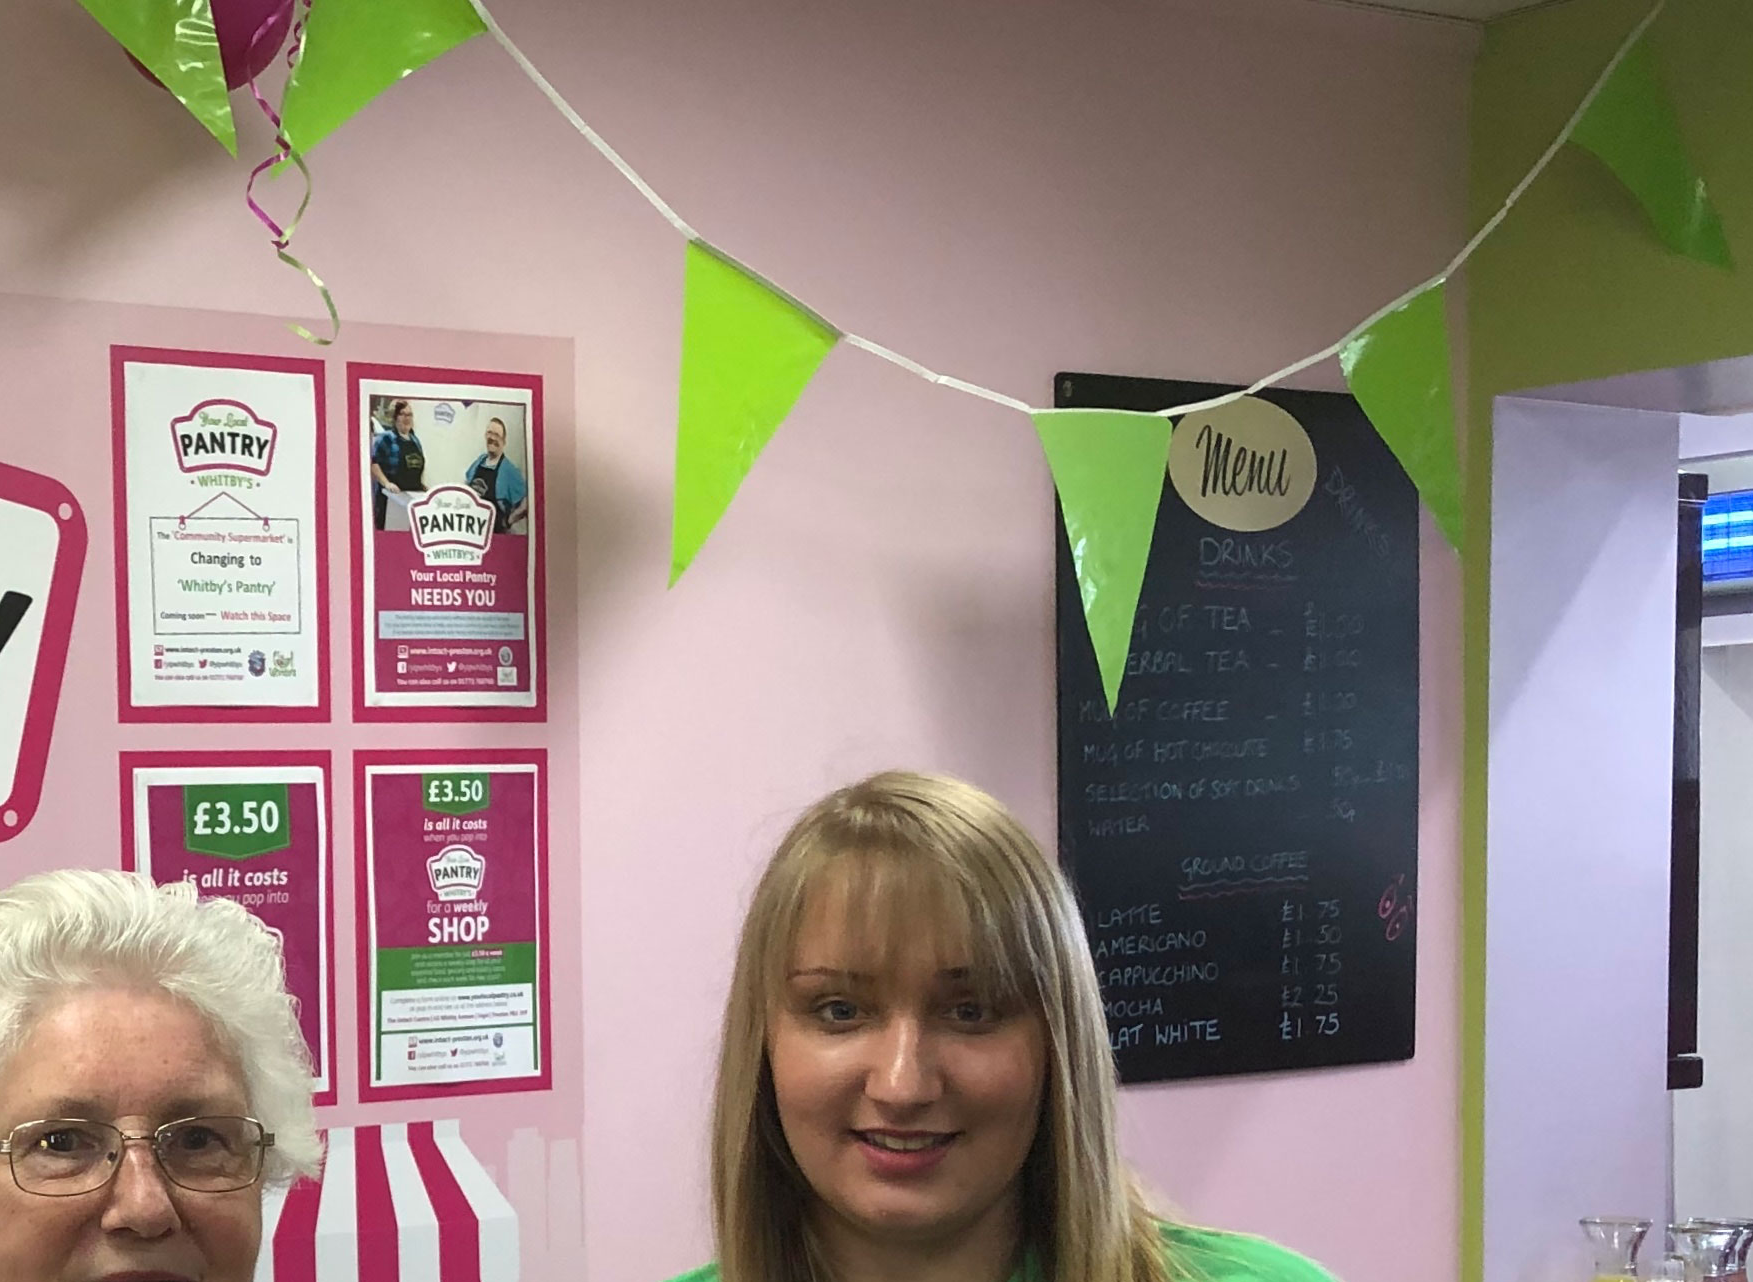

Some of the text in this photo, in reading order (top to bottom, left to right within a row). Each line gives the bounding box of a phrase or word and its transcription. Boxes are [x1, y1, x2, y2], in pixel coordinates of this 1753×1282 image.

[180, 432, 269, 459] PANTRY
[1195, 425, 1292, 498] Menu
[198, 475, 253, 489] WHITBY'S
[419, 514, 486, 536] PANTRY
[191, 552, 262, 567] Changing to
[433, 549, 475, 560] WHITBY'S
[1199, 537, 1293, 568] DRINKS
[410, 569, 496, 586] Your Local Pantry
[411, 589, 495, 606] NEEDS YOU
[161, 611, 186, 620] Coming
[221, 611, 248, 620] Watch
[251, 611, 265, 620] this
[268, 612, 291, 623] Space
[1203, 604, 1251, 632] TEA
[1127, 650, 1250, 676] ERBAL TEA
[1158, 700, 1230, 722] COFFEE
[428, 780, 483, 803] £3.50
[194, 801, 279, 834] £3.50
[424, 818, 487, 830] is all it costs
[434, 866, 480, 881] PANTRY
[1180, 851, 1308, 880] GROUND COFFEE
[202, 869, 223, 887] all
[228, 868, 240, 887] it
[245, 869, 288, 886] costs
[267, 890, 289, 903] into
[427, 901, 488, 914] for a weekly
[1097, 903, 1163, 928] LATTE
[428, 916, 489, 943] SHOP
[1095, 930, 1206, 958] AMERICANO
[1109, 1024, 1143, 1050] LAT
